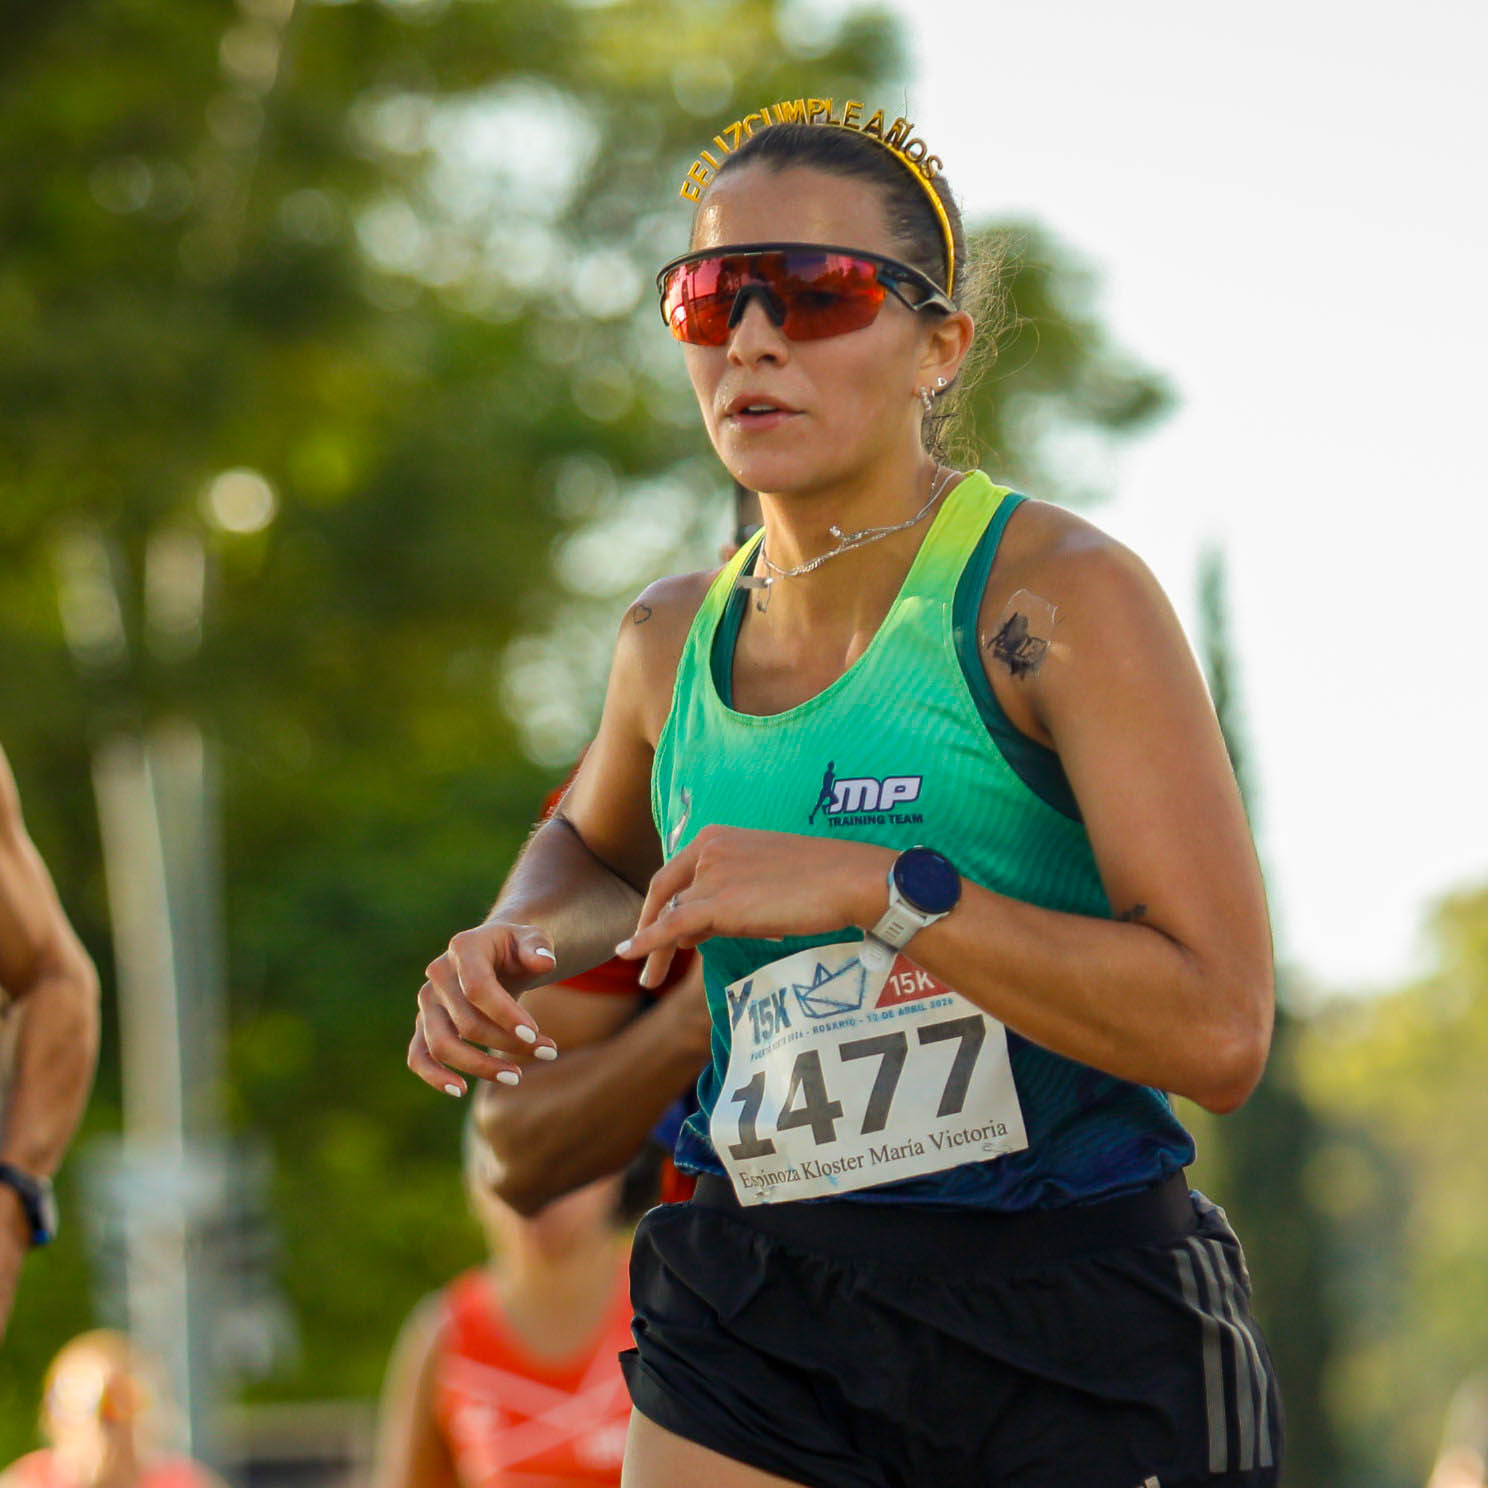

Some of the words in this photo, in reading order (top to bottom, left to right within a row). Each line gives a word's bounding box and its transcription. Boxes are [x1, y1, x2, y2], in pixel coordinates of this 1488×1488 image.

[828, 775, 924, 815] MP
[828, 815, 886, 828] TRAINING
[889, 813, 924, 825] TEAM
[889, 970, 936, 997] 15K
[748, 986, 792, 1045] 15K
[813, 1018, 857, 1034] ROSARIO
[727, 1013, 986, 1161] 1477
[738, 1167, 801, 1190] Espinoza
[801, 1153, 865, 1180] Kloster
[869, 1137, 925, 1166] María
[928, 1119, 1009, 1151] Victoria
